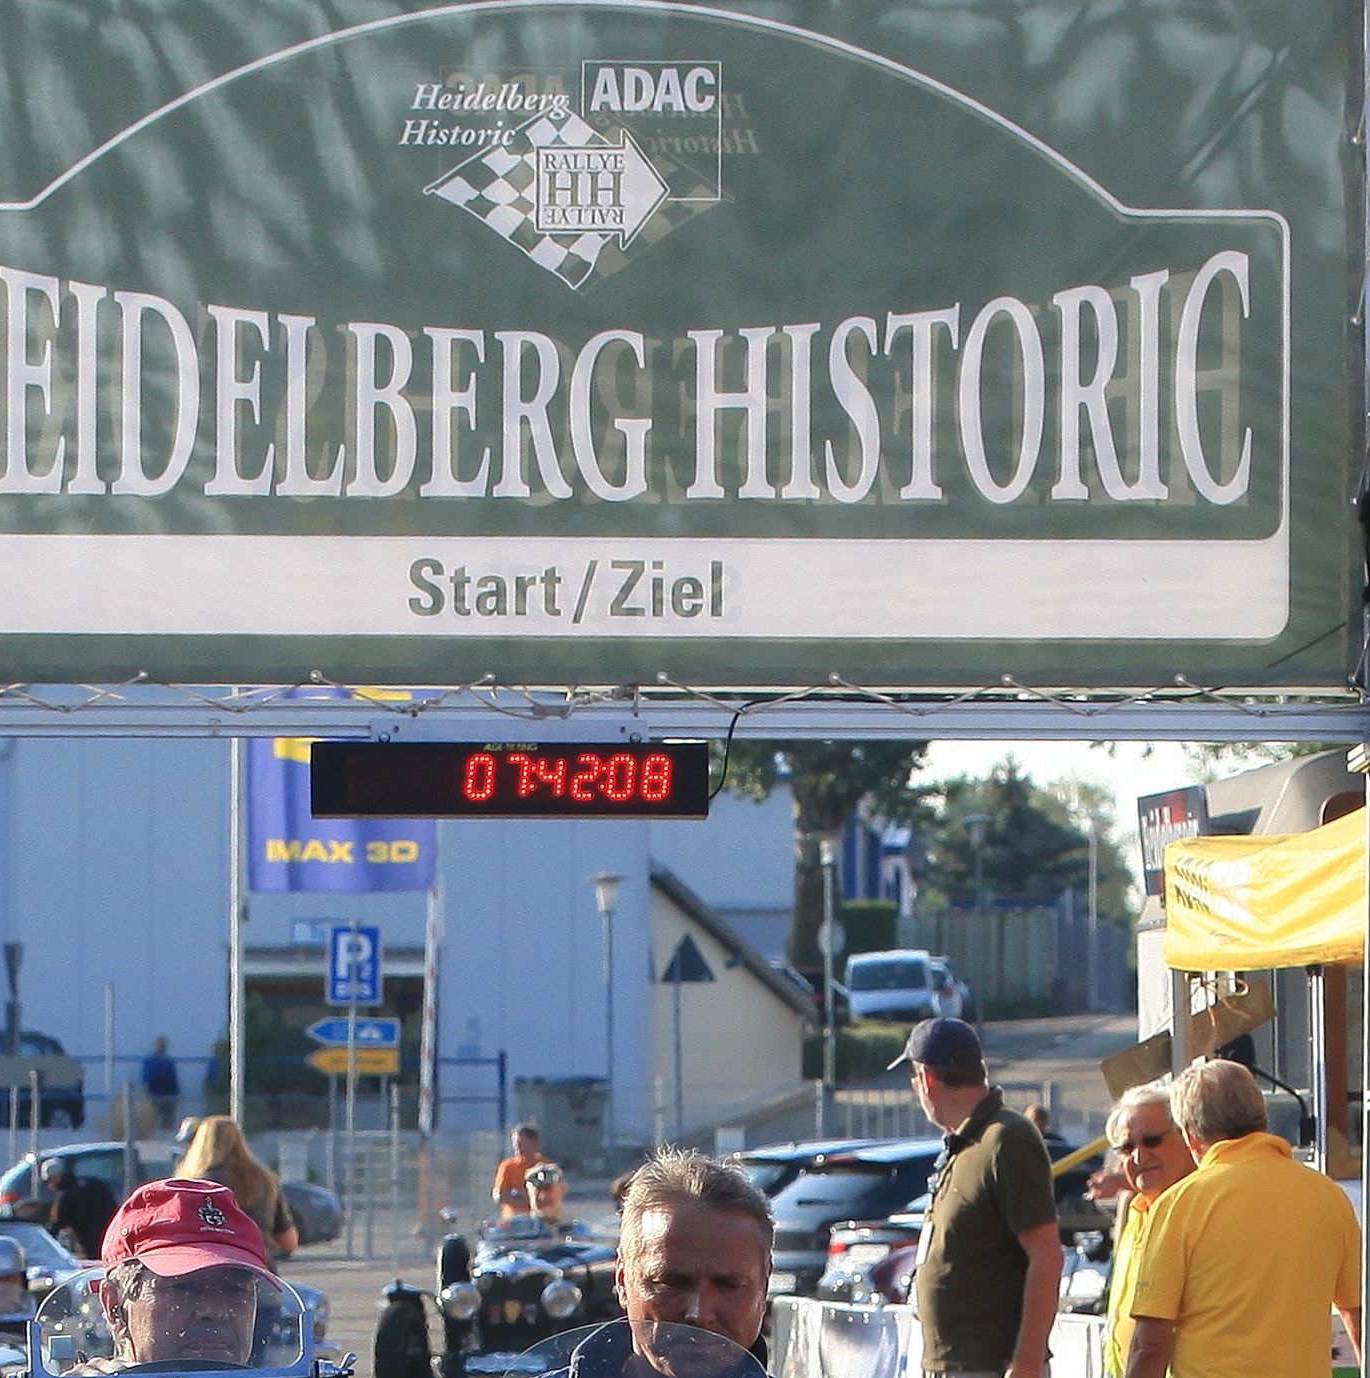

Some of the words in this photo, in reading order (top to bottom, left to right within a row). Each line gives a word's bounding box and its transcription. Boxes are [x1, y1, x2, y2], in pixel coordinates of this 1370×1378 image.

[410, 84, 570, 120] Heidelberg
[590, 68, 716, 113] ADAC
[399, 119, 518, 147] Historic
[543, 153, 625, 170] RALLYE
[547, 170, 626, 208] HH
[685, 250, 1252, 506] HISTORIC
[465, 753, 673, 800] 07:42:08
[265, 839, 355, 863] IMAX
[365, 840, 420, 863] 3D
